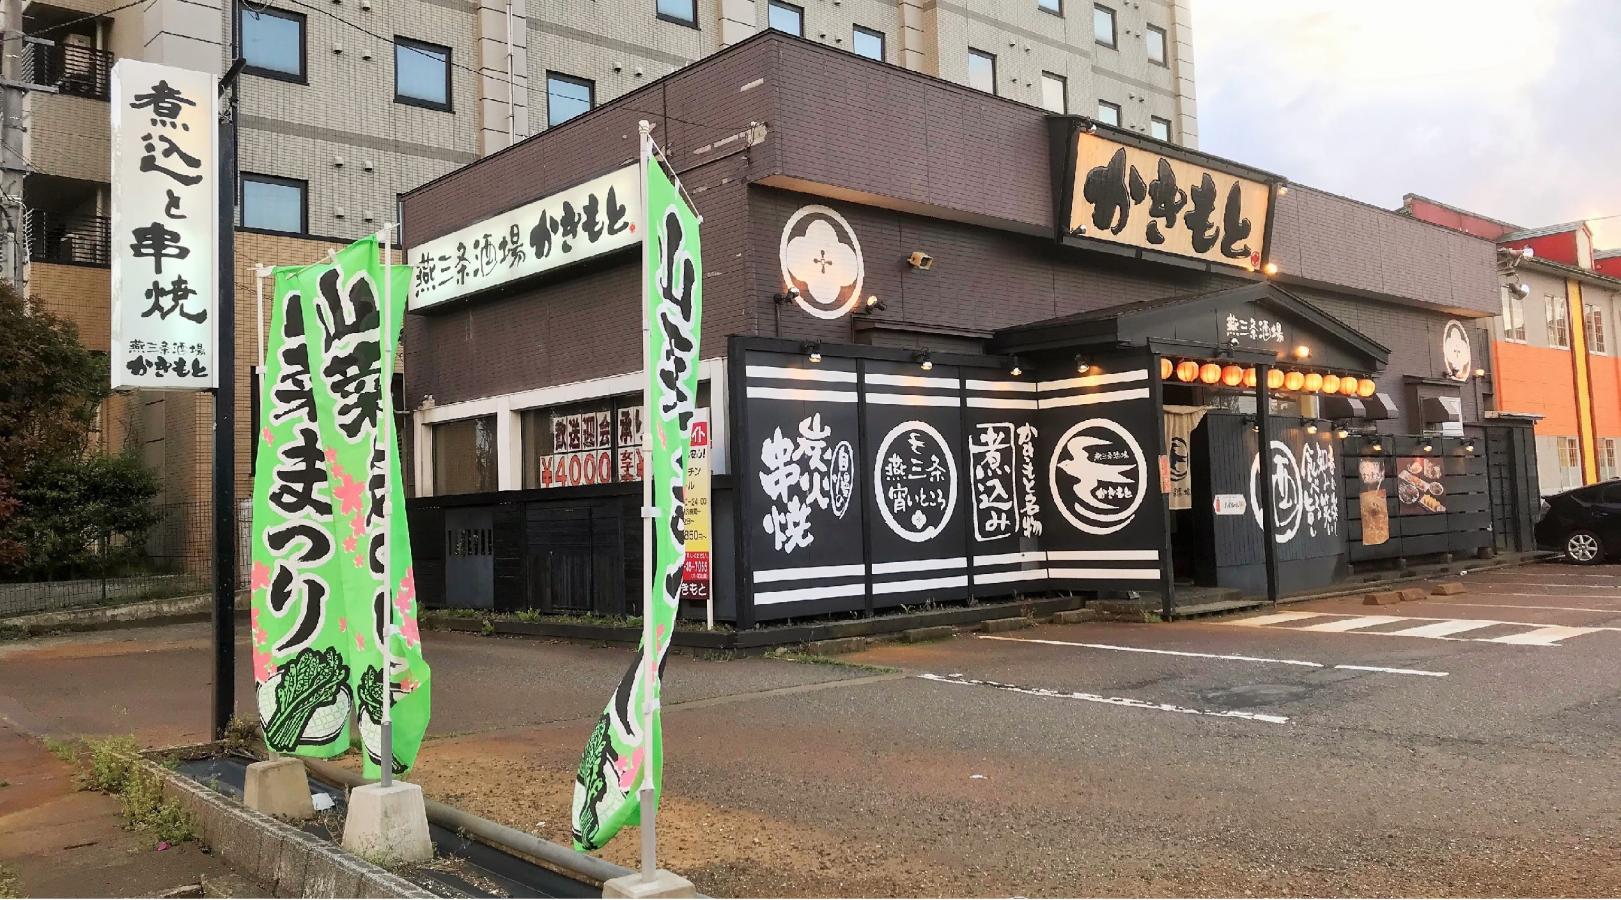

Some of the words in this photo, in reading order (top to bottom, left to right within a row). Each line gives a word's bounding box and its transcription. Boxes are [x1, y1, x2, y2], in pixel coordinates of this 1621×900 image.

[129, 80, 207, 324] 煮込と串焼
[415, 223, 526, 297] 燕三条酒場
[530, 184, 629, 260] かきもと
[1084, 147, 1251, 259] かきもと
[126, 355, 208, 377] かきもと
[1226, 312, 1285, 342] 燕三条酒場
[885, 453, 946, 482] 燕三条
[972, 427, 1013, 532] 煮込み
